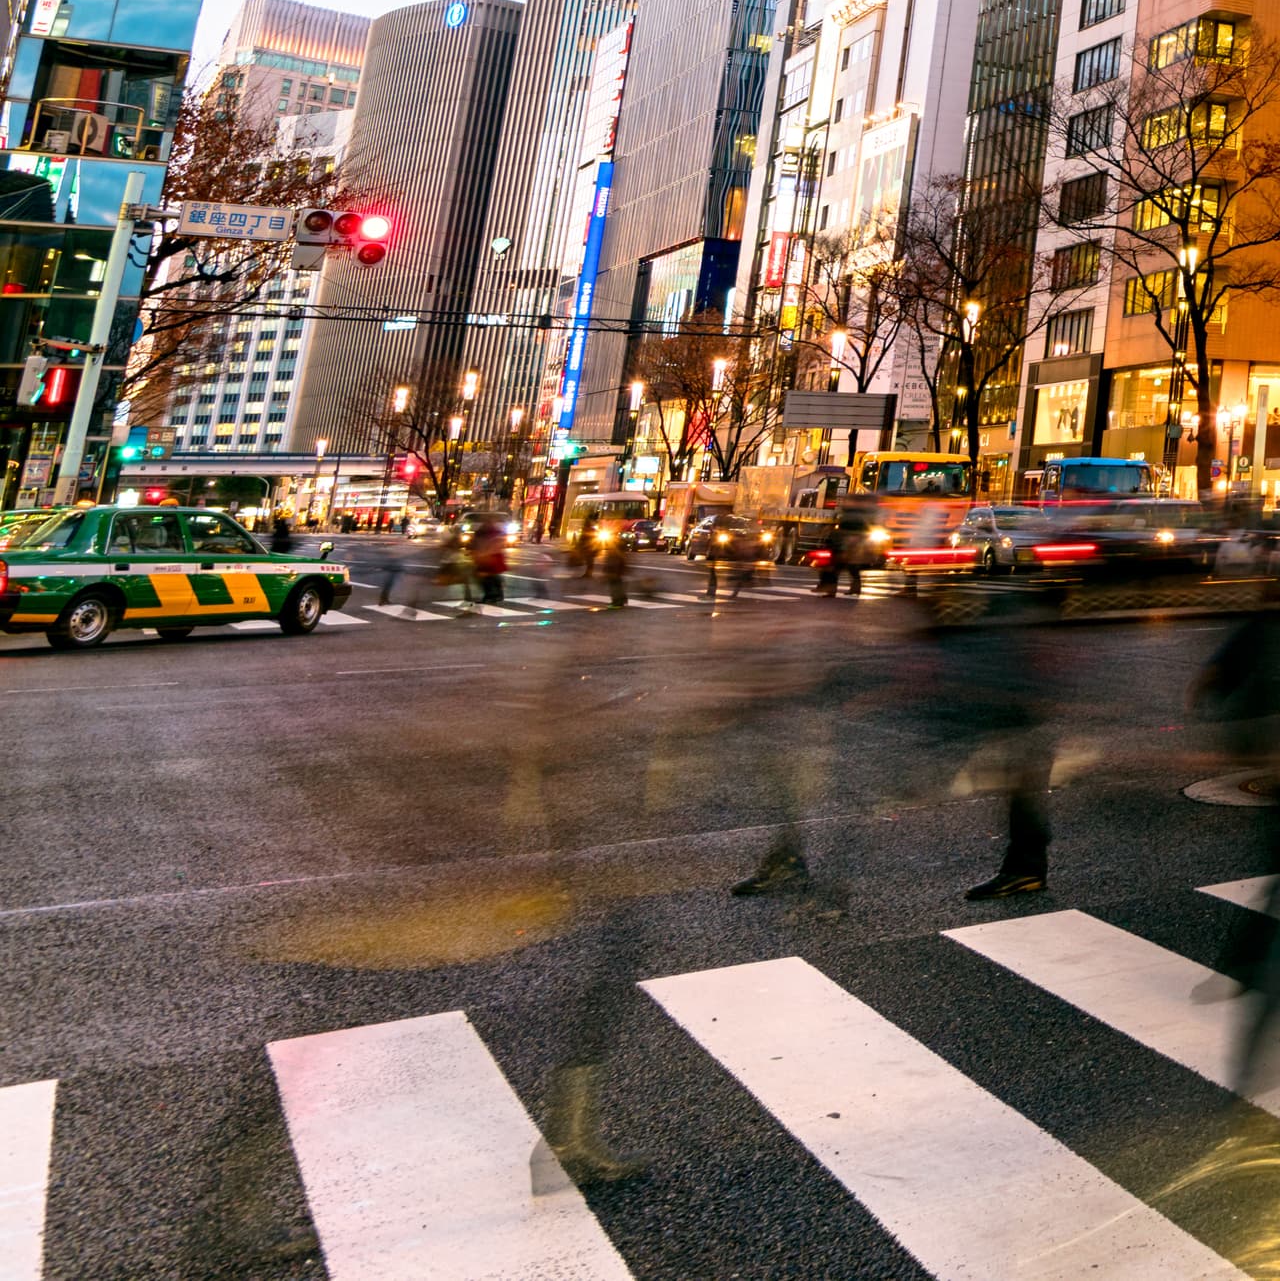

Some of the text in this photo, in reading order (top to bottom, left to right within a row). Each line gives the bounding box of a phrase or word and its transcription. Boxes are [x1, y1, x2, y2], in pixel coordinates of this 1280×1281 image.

[188, 209, 286, 230] 銀座四丁目
[216, 226, 243, 235] Ginza
[962, 434, 990, 448] GCI
